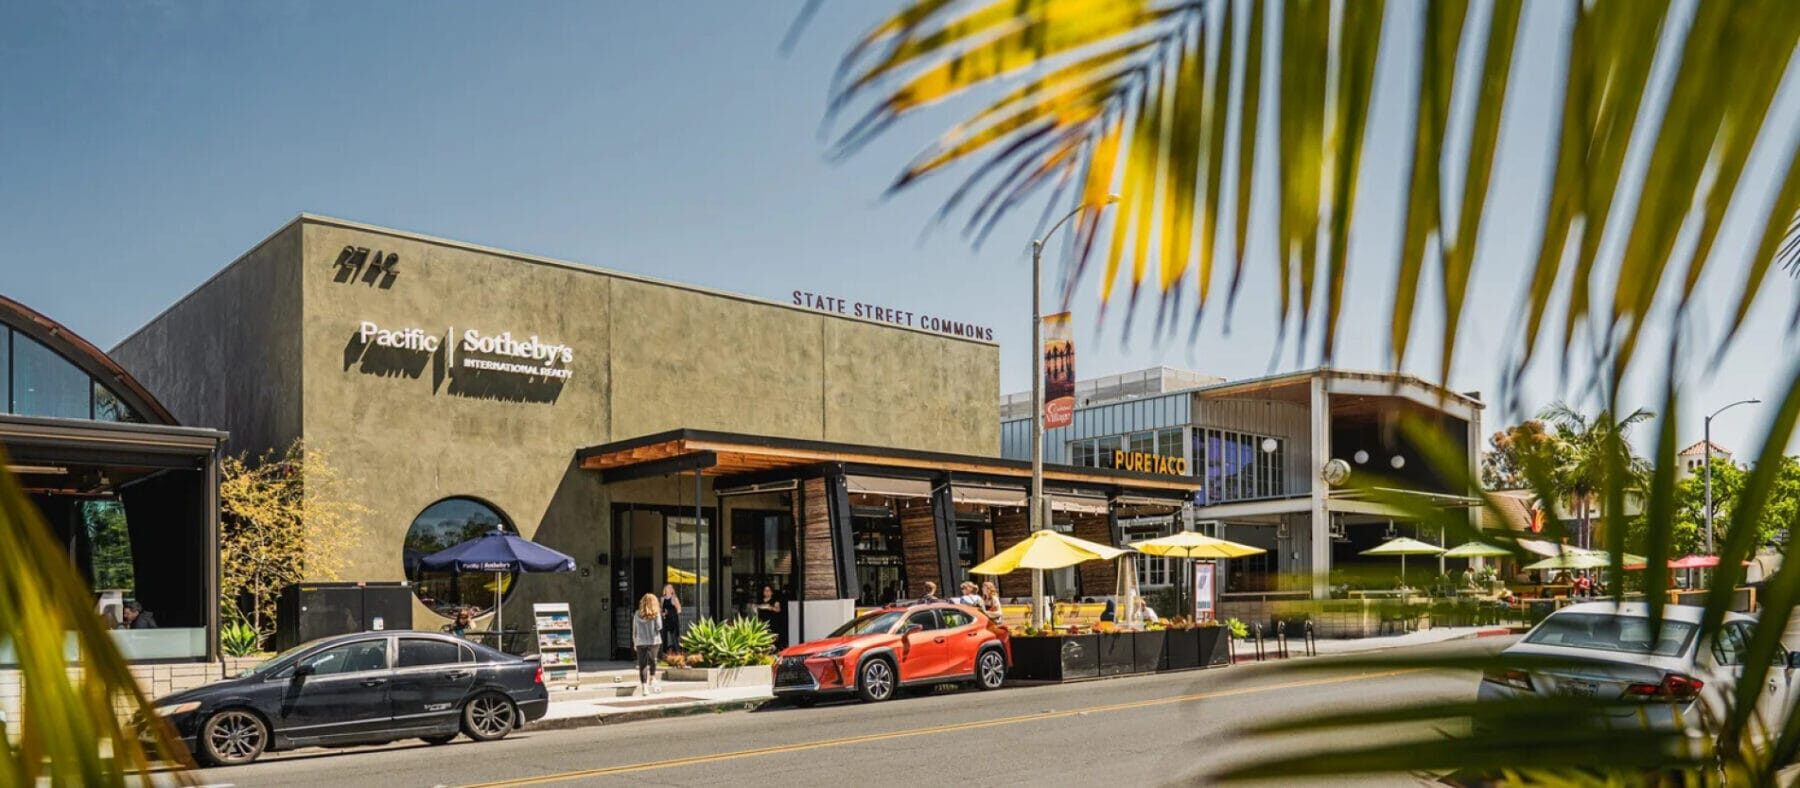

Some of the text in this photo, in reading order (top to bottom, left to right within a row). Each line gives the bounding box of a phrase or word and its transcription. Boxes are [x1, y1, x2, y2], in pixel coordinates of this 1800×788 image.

[793, 290, 993, 341] STATE STREET COMMONS
[360, 320, 573, 366] Pacific Sotheby's
[463, 358, 540, 375] INTERNATIONAL
